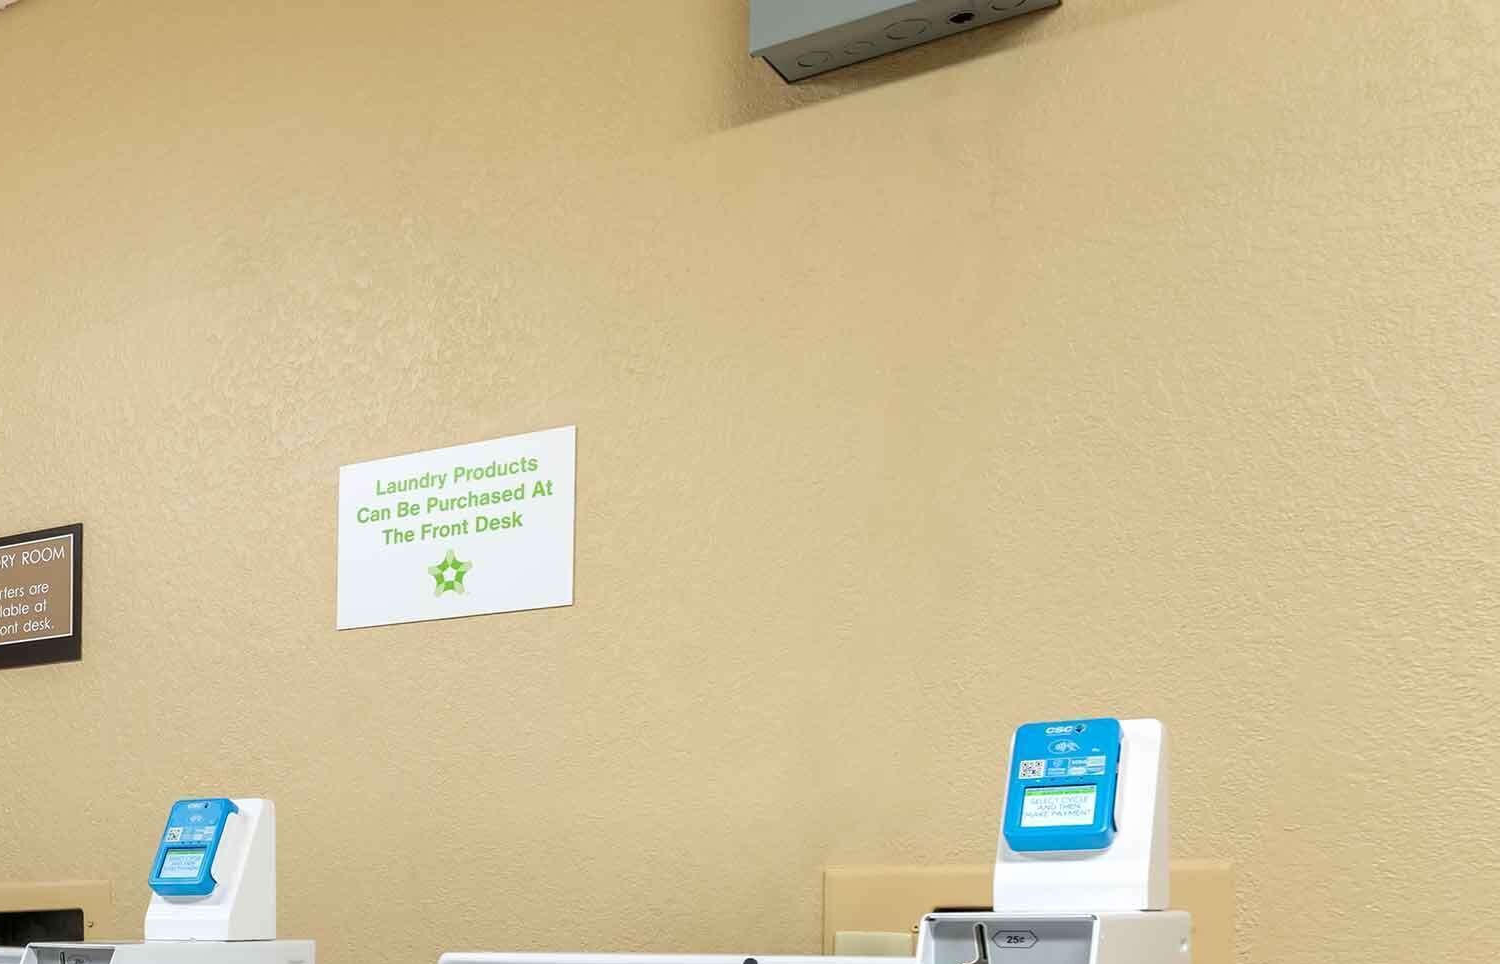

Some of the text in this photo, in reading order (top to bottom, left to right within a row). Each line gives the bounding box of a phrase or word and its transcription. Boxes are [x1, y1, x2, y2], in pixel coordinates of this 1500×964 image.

[375, 456, 539, 496] Laundry Products
[357, 479, 554, 524] Can Be Purchased At
[382, 511, 524, 545] The Front Desk
[21, 546, 65, 566] ROOM
[28, 582, 50, 594] are
[34, 600, 47, 612] at
[23, 616, 55, 632] desk.
